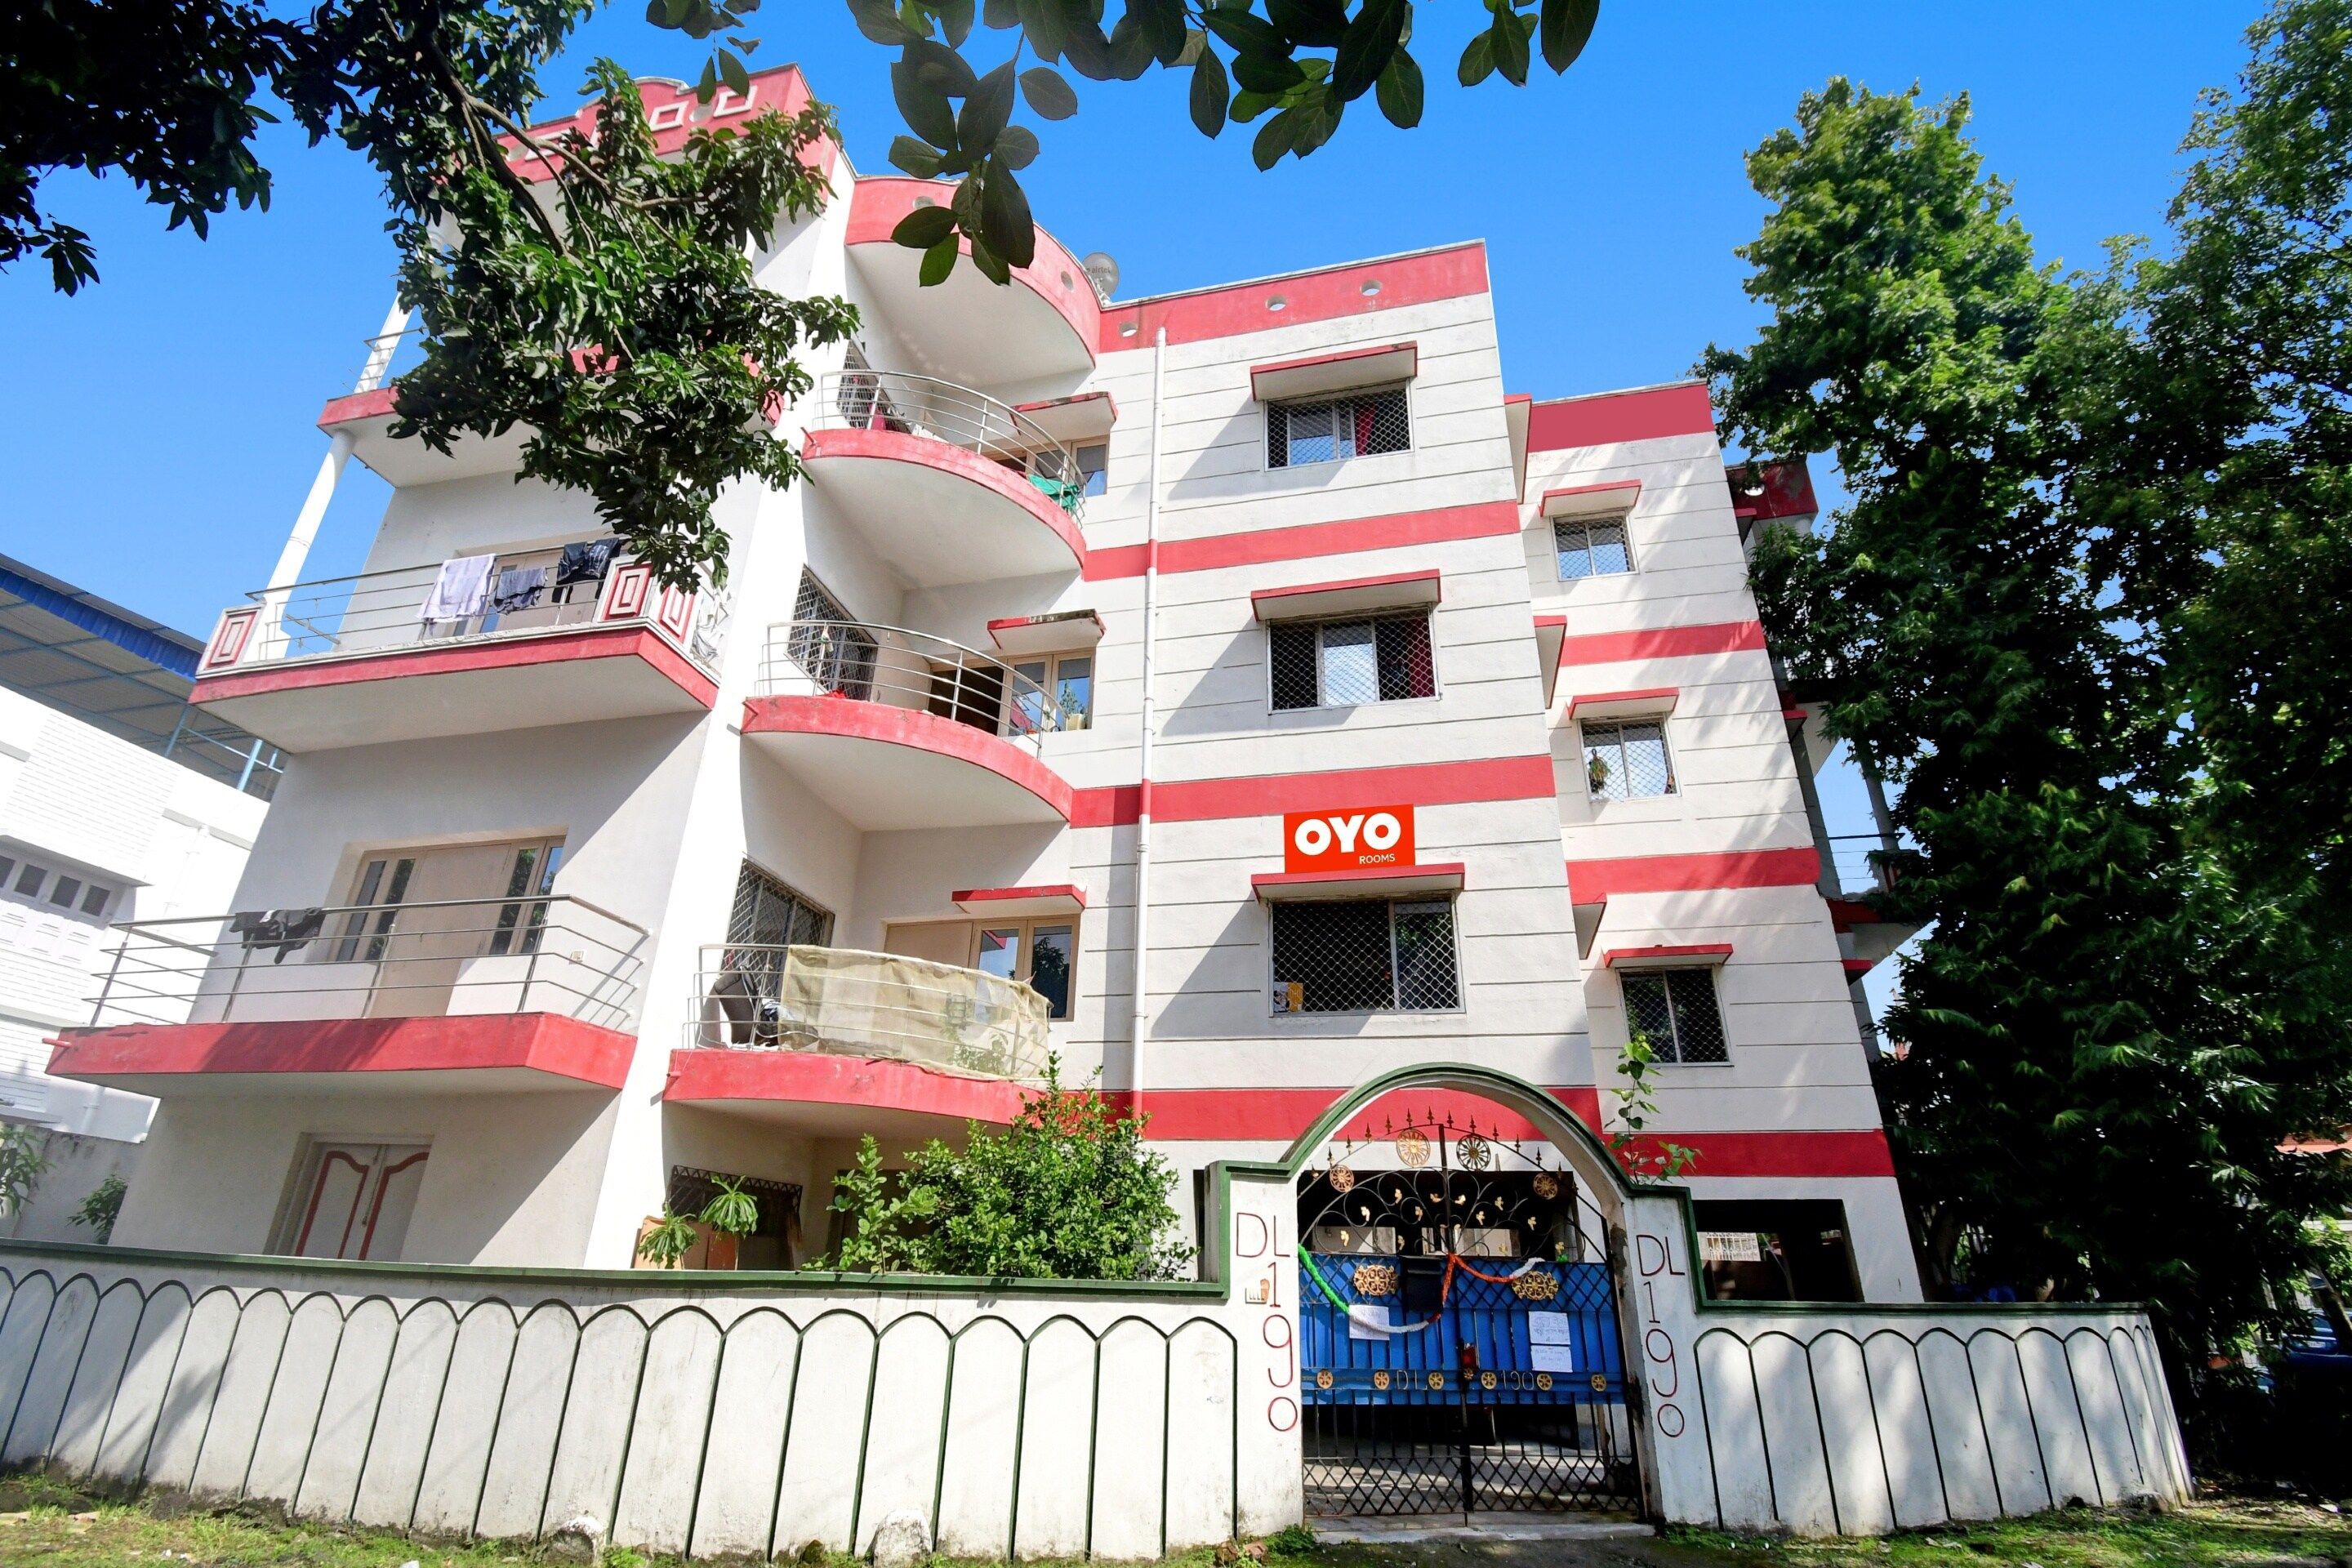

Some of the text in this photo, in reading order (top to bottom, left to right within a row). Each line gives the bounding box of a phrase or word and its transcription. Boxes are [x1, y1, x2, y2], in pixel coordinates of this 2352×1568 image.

[1294, 813, 1401, 856] OYO
[1359, 853, 1396, 865] ROOMS
[1236, 1212, 1290, 1258] DL
[1636, 1234, 1686, 1276] DL
[1396, 1369, 1428, 1390] DL
